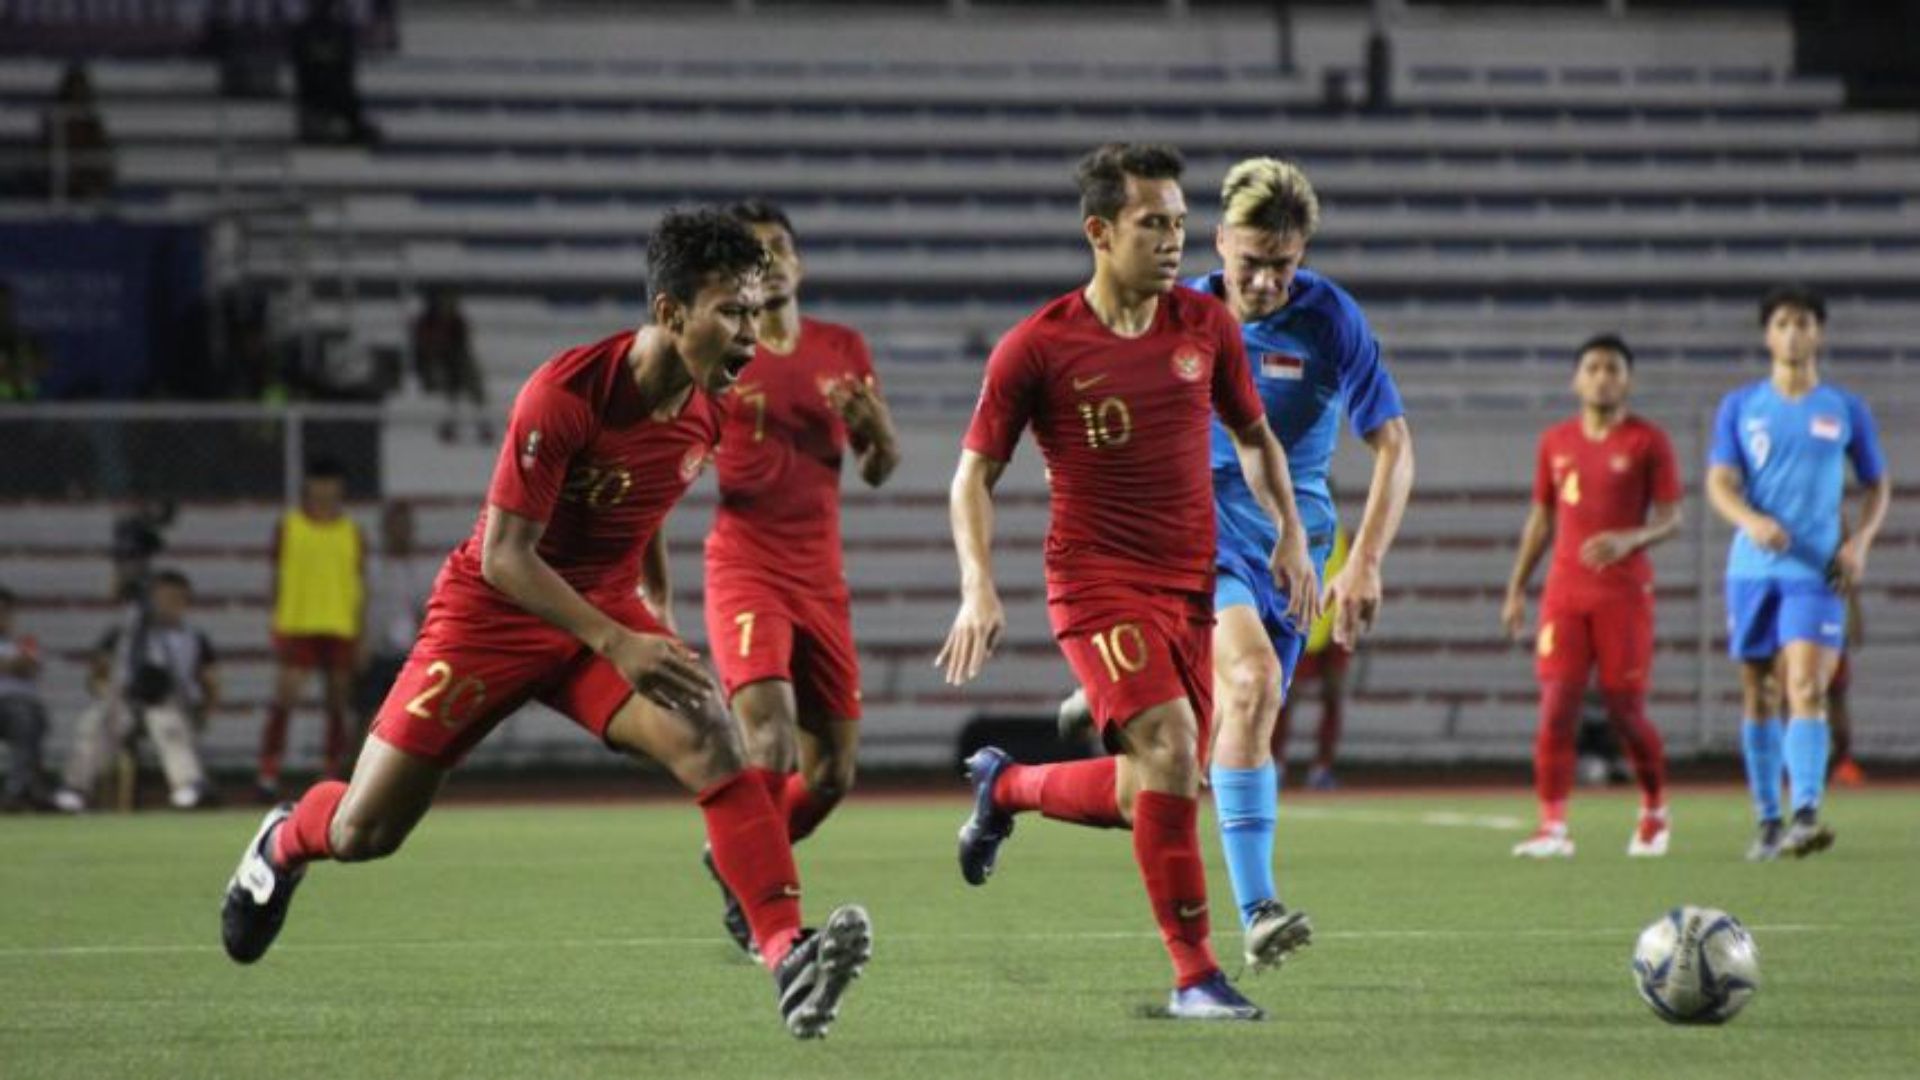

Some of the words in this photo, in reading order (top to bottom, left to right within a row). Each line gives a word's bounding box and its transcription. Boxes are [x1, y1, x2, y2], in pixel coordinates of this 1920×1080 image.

[742, 393, 766, 441] 7
[1078, 397, 1131, 449] 10
[1090, 623, 1147, 683] 10
[404, 660, 486, 729] 20
